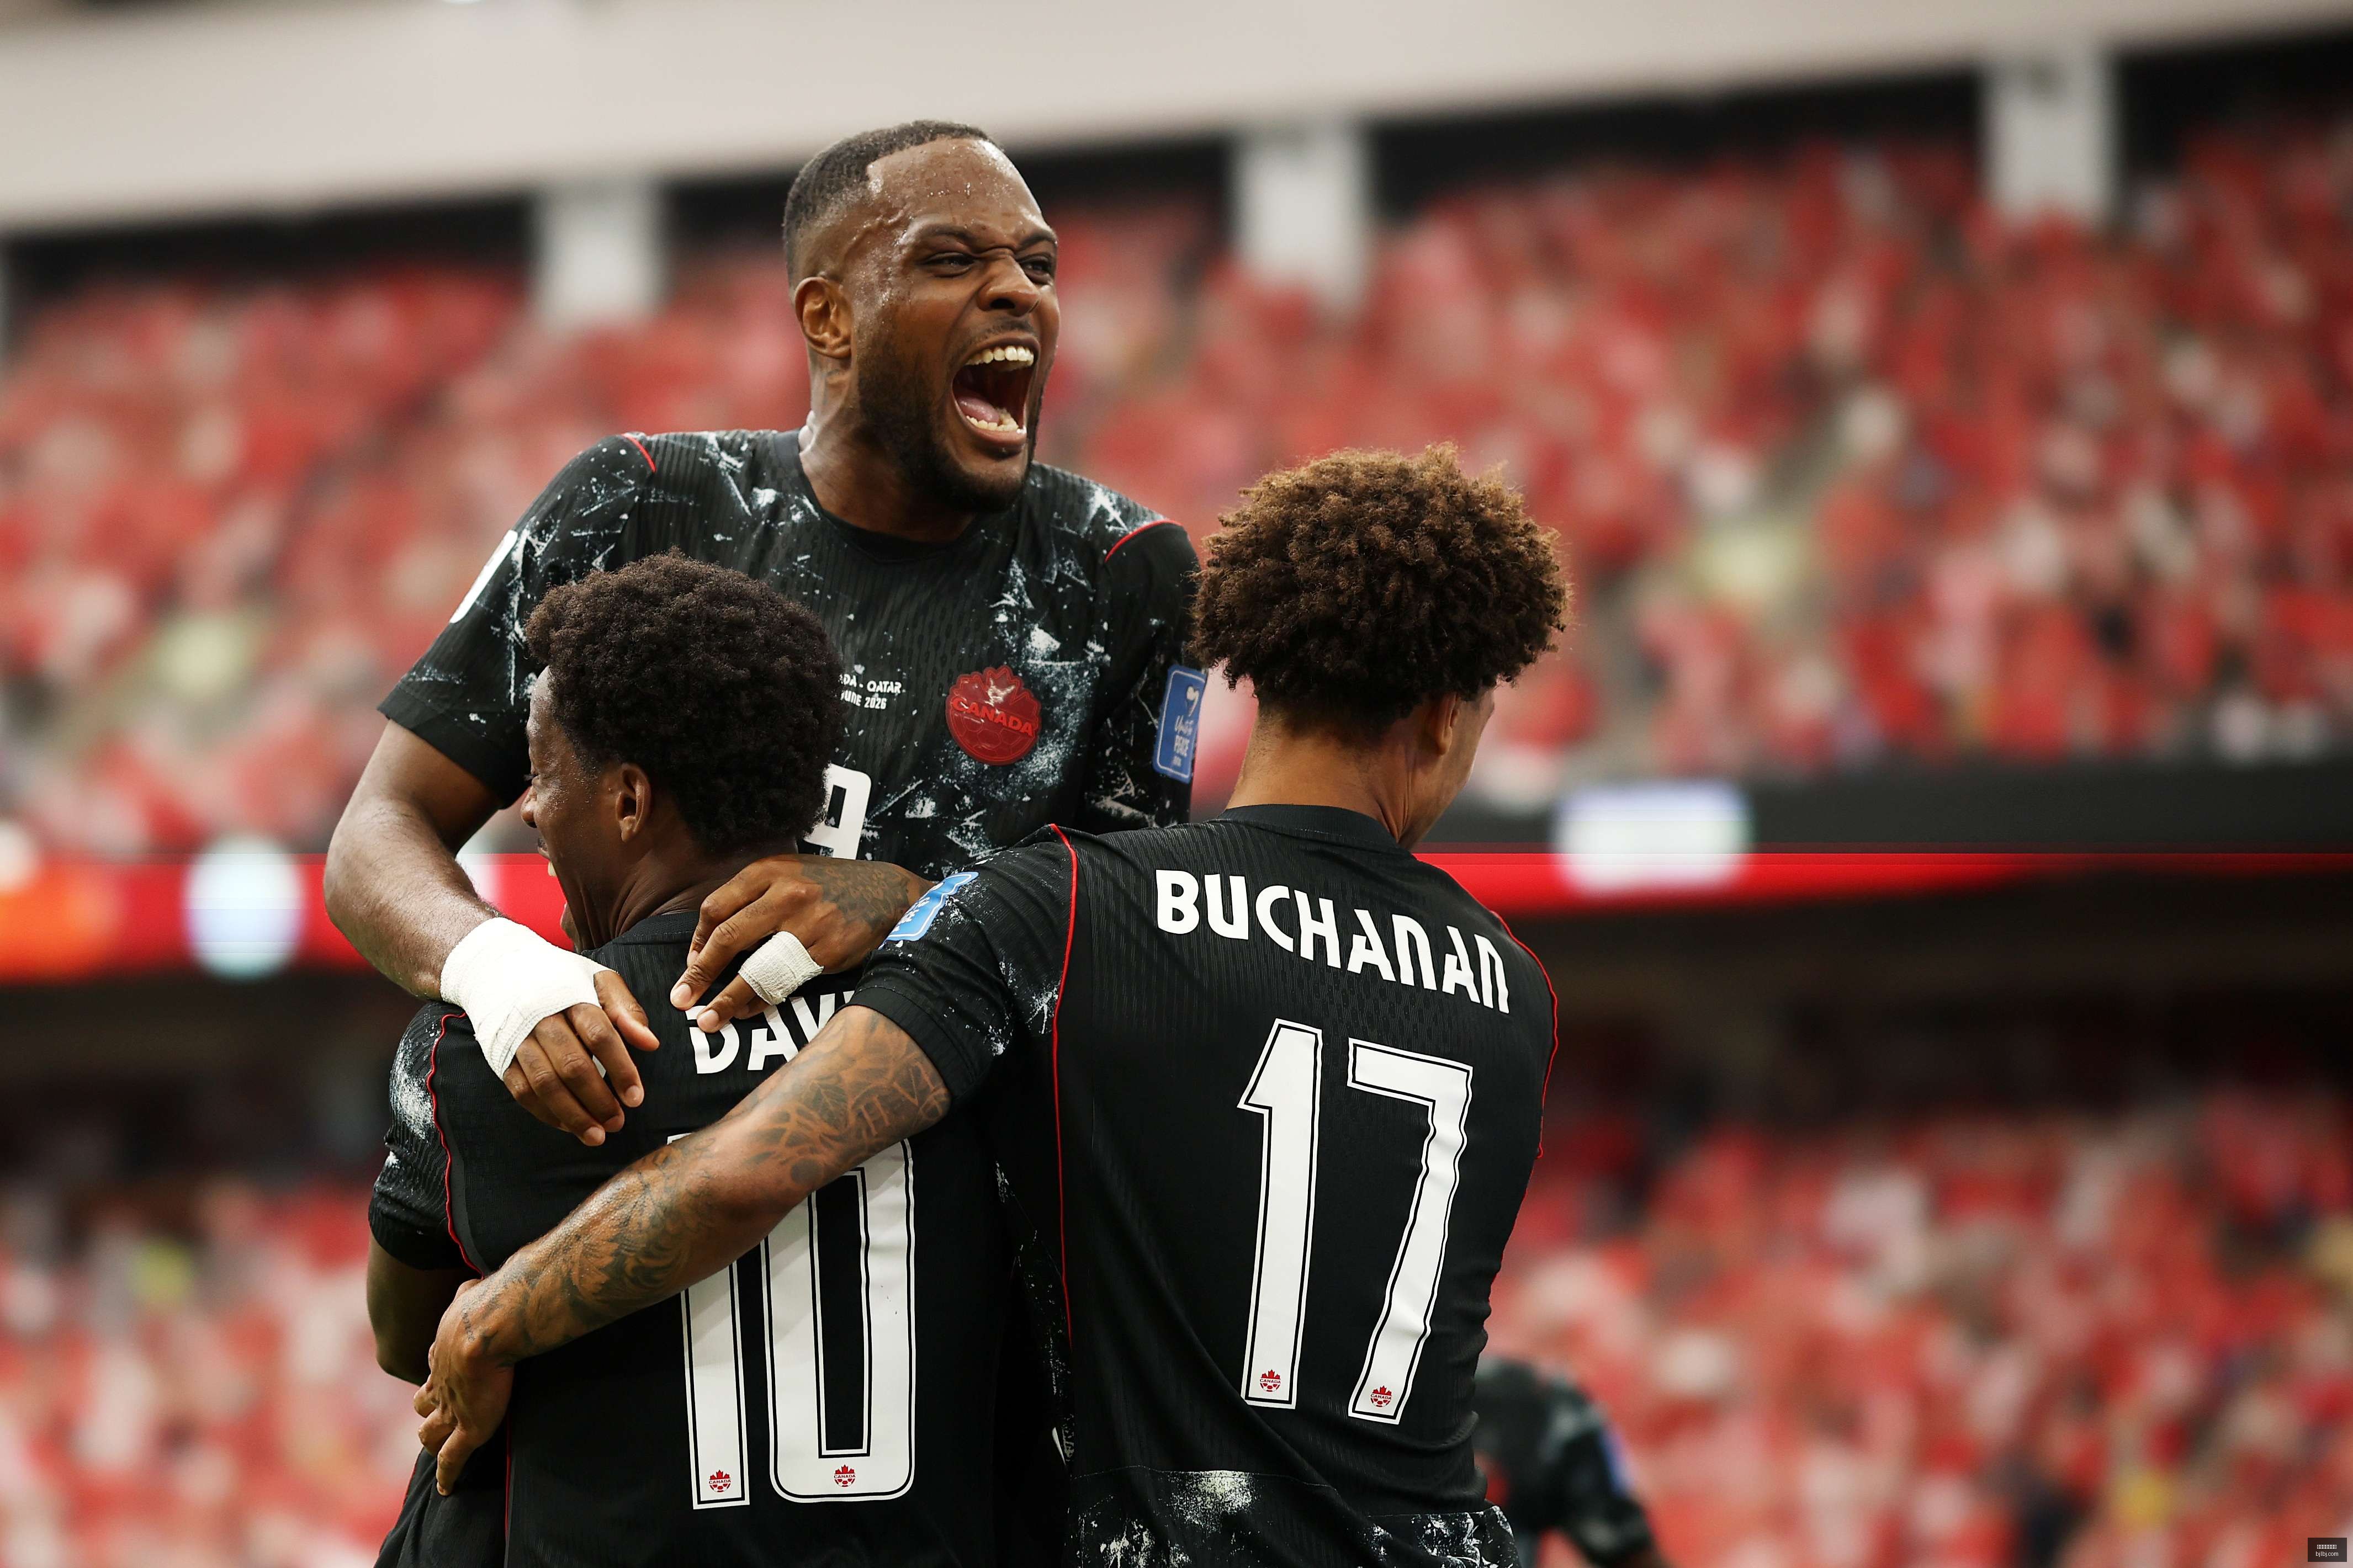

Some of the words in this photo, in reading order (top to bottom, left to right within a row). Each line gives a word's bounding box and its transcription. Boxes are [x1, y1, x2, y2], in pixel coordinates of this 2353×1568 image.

[864, 697, 887, 709] 2026
[867, 681, 902, 694] QATAR
[952, 697, 1034, 737] CANADA
[1156, 869, 1509, 1014] BUCHANAN
[685, 990, 855, 1074] DAV
[1237, 1018, 1473, 1425] 17
[667, 1133, 915, 1510] 10
